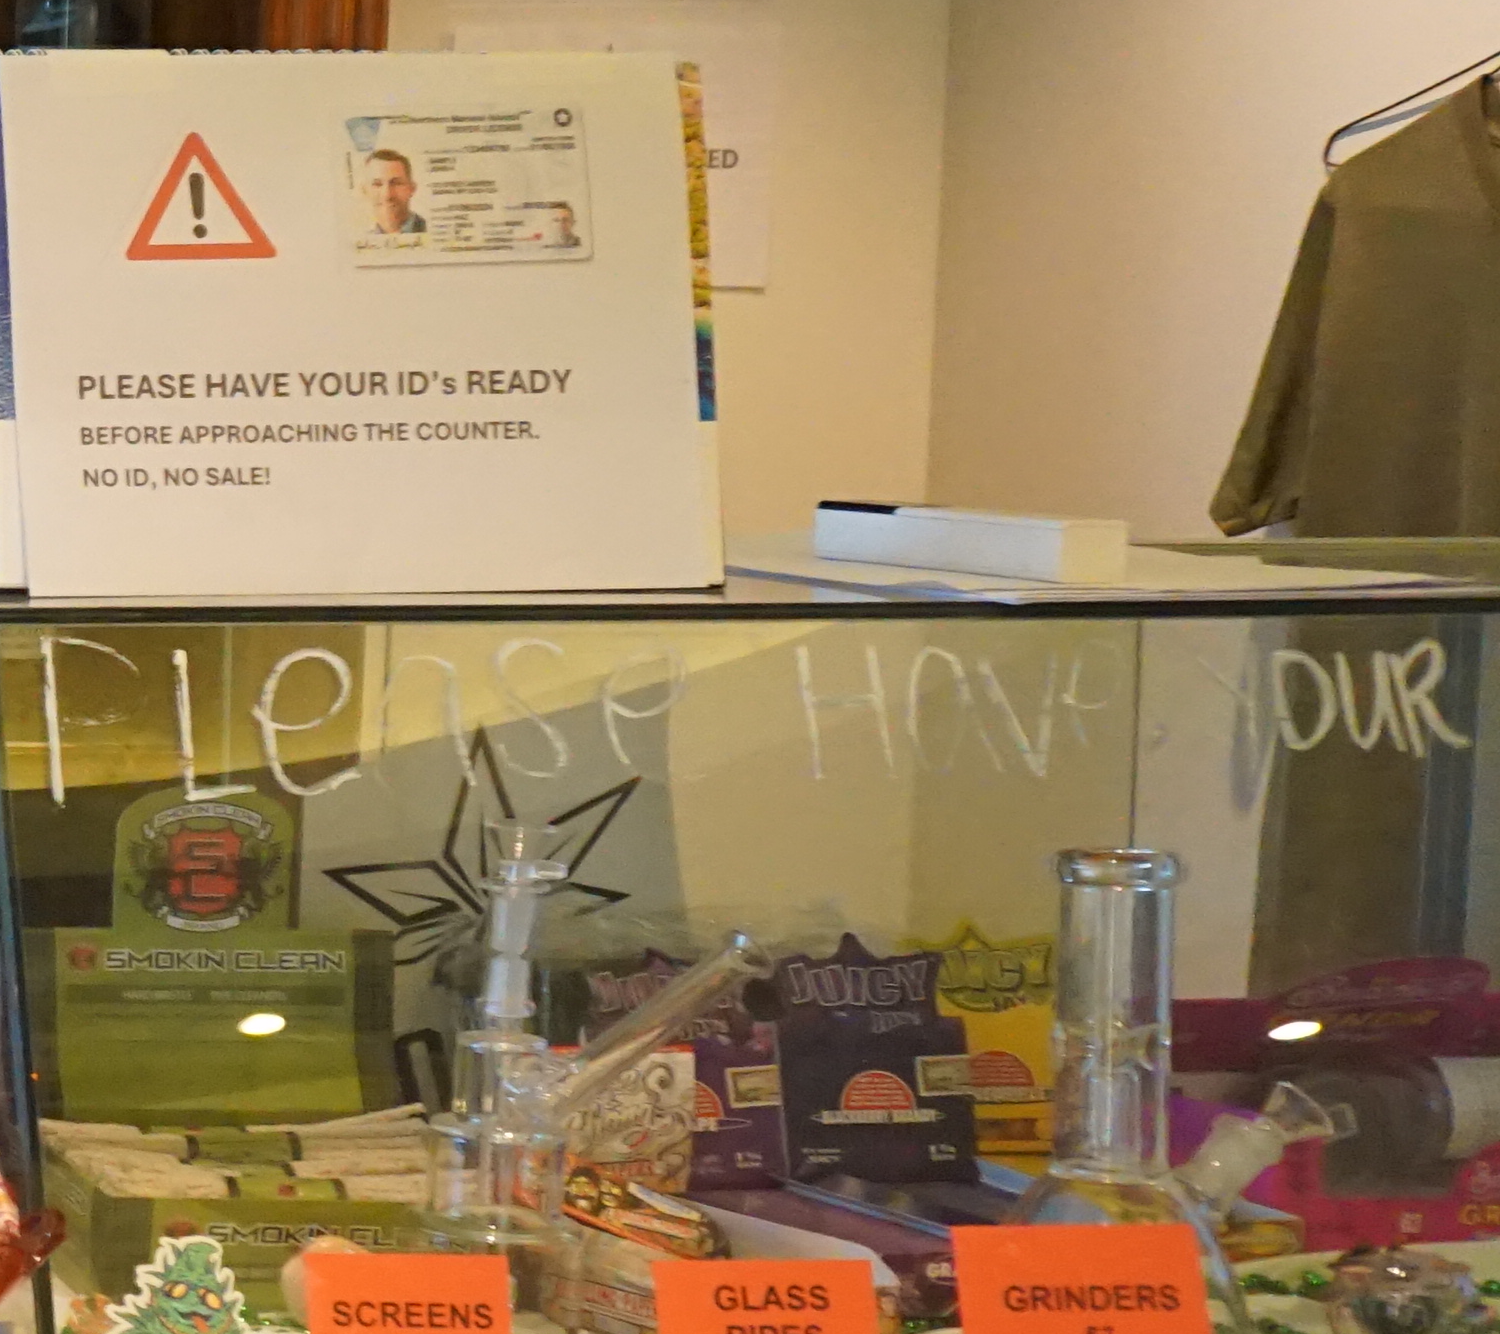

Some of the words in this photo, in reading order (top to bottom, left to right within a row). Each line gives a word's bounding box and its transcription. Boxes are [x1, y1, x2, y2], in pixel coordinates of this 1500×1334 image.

[77, 373, 196, 400] PLEASE
[205, 372, 291, 399] HAVE
[297, 370, 390, 397] YOUR
[398, 370, 459, 396] ID's
[466, 369, 573, 395] READY
[80, 425, 173, 445] BEFORE
[179, 423, 359, 444] APPROACHING
[363, 422, 410, 442] THE
[416, 421, 542, 442] COUNTER.
[82, 468, 118, 487] NO
[126, 467, 158, 491] ID,
[163, 467, 200, 487] NO
[205, 466, 272, 486] SALE!
[104, 947, 227, 973] SMOKIN
[234, 949, 347, 973] CLEAN
[787, 959, 928, 1007] JUICY
[714, 1284, 831, 1312] GLASS
[1004, 1285, 1181, 1312] GRINDERS
[332, 1300, 494, 1330] SCREENS
